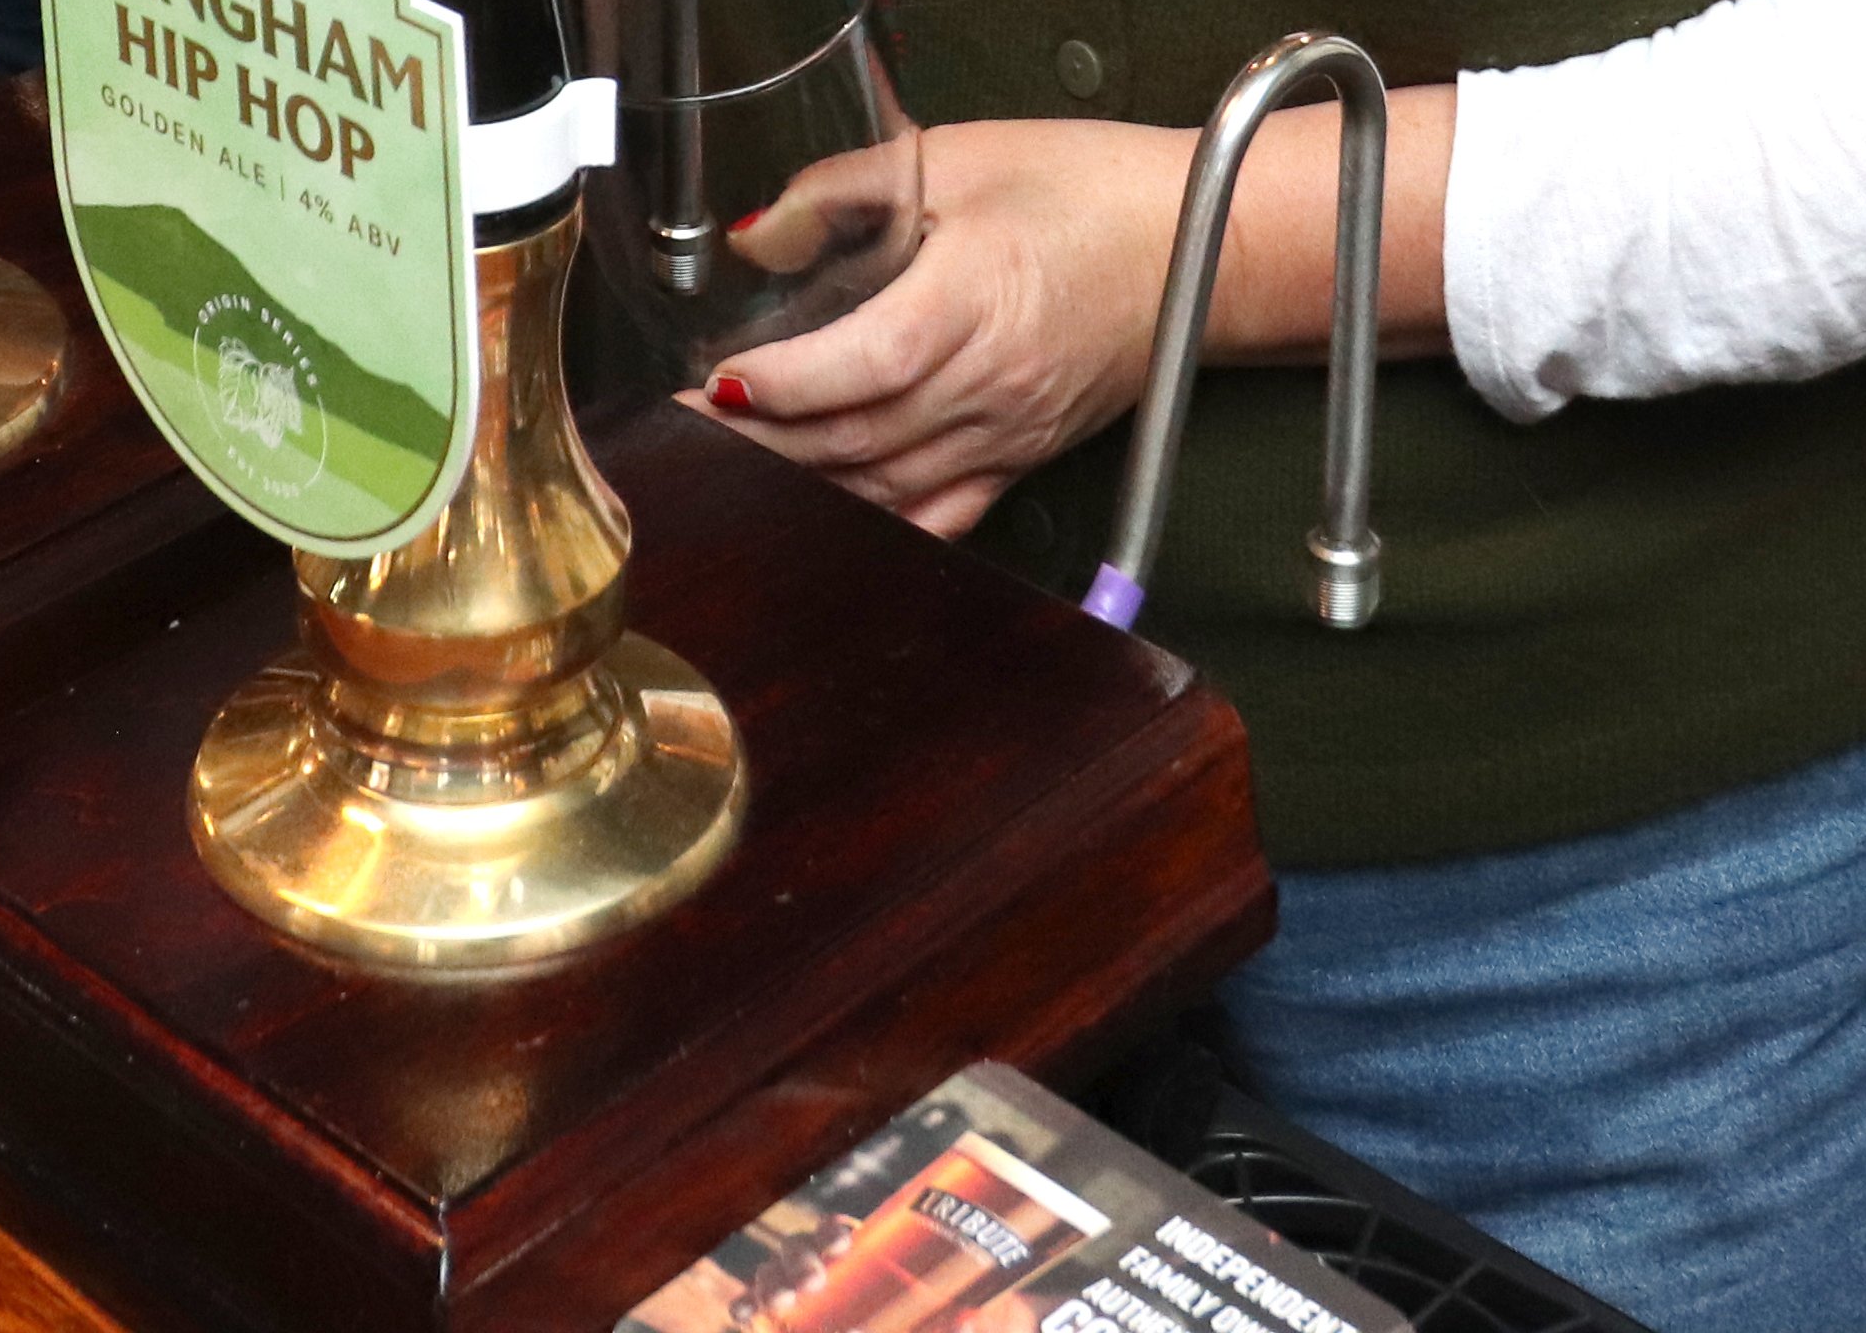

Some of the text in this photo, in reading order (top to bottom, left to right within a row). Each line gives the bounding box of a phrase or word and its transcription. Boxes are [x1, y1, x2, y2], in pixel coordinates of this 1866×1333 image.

[114, 1, 376, 181] HIP HOP
[100, 83, 402, 258] GOLDEN ALE 4% ABV
[197, 292, 252, 326] ORIGIN
[919, 1187, 1029, 1269] TRIBUTE
[1117, 1244, 1223, 1319] FAMILY
